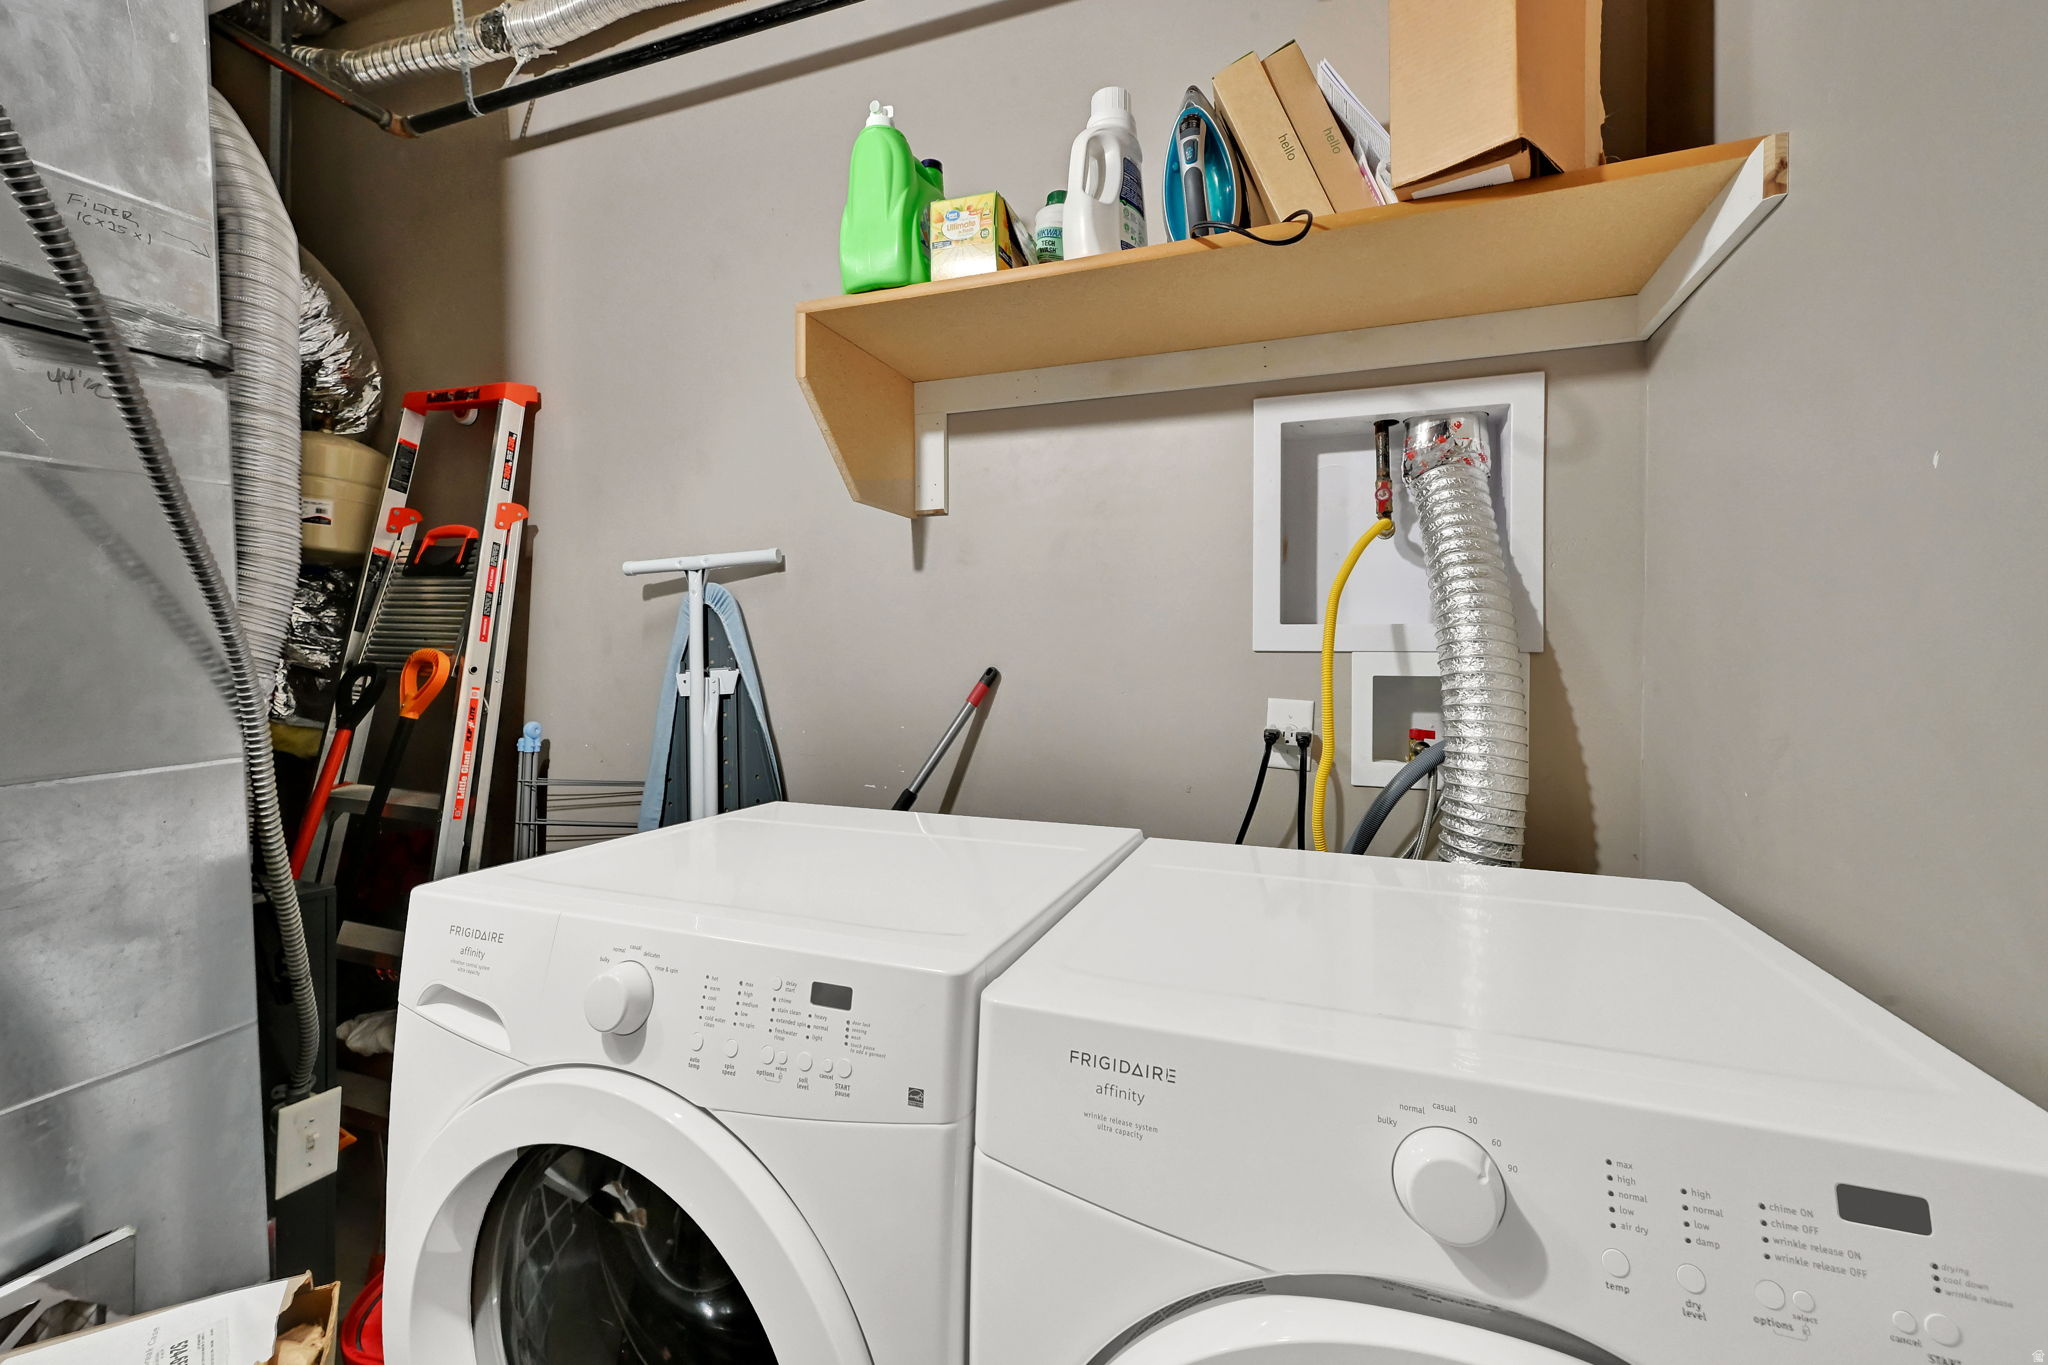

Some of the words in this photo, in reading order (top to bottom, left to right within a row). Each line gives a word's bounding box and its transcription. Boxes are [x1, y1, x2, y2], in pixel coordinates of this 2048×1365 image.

[1278, 133, 1296, 161] hello
[1323, 127, 1341, 154] hello
[461, 751, 471, 774] Giant
[457, 776, 467, 799] Little
[449, 925, 505, 944] FRIGIDAIRE
[460, 946, 486, 961] affinity
[776, 1018, 796, 1026] extended
[814, 1013, 827, 1022] heavy
[775, 1027, 798, 1037] freshwater
[813, 1024, 829, 1032] normal
[812, 1034, 823, 1042] light
[1069, 1050, 1177, 1084] FRIGIDAIRE
[756, 1070, 775, 1078] options
[835, 1083, 850, 1091] START
[834, 1090, 850, 1098] pause
[1095, 1083, 1145, 1106] affinity
[1399, 1103, 1426, 1115] normal
[1432, 1102, 1457, 1113] casual
[1083, 1111, 1108, 1122] wrinkle
[1109, 1117, 1133, 1128] release
[1135, 1122, 1159, 1134] system
[1377, 1115, 1398, 1128] bulky
[1468, 1116, 1478, 1125] 30
[1097, 1123, 1113, 1133] ultra
[1115, 1127, 1144, 1141] capacity
[1491, 1139, 1502, 1148] 60
[1507, 1164, 1518, 1173] 90
[1616, 1161, 1633, 1170] max
[1617, 1174, 1636, 1186] high
[1619, 1191, 1648, 1204] normal
[1691, 1188, 1711, 1200] high
[1619, 1205, 1635, 1216] low
[1693, 1205, 1724, 1218] normal
[1769, 1203, 1797, 1216] chime
[1800, 1208, 1814, 1218] ON
[1621, 1223, 1632, 1231] air
[1635, 1225, 1649, 1237] dry
[1694, 1220, 1710, 1231] low
[1771, 1220, 1799, 1232] chime
[1802, 1225, 1819, 1235] OFF
[1696, 1237, 1721, 1250] damp
[1772, 1237, 1807, 1250] wrinkle
[1810, 1243, 1844, 1257] release
[1847, 1250, 1862, 1261] ON
[1774, 1253, 1809, 1267] wrinkle
[1812, 1261, 1847, 1275] release
[1850, 1267, 1868, 1279] OFF
[1941, 1263, 1970, 1277] drying
[1605, 1280, 1630, 1295] temp
[1943, 1277, 1962, 1286] cool
[1965, 1280, 1990, 1291] down
[1685, 1299, 1702, 1311] dry
[1945, 1290, 1978, 1302] wrinkle
[1981, 1297, 2014, 1309] release
[1682, 1307, 1708, 1322] level
[1792, 1313, 1819, 1325] select
[1753, 1315, 1795, 1332] options
[1889, 1334, 1923, 1348] cancel
